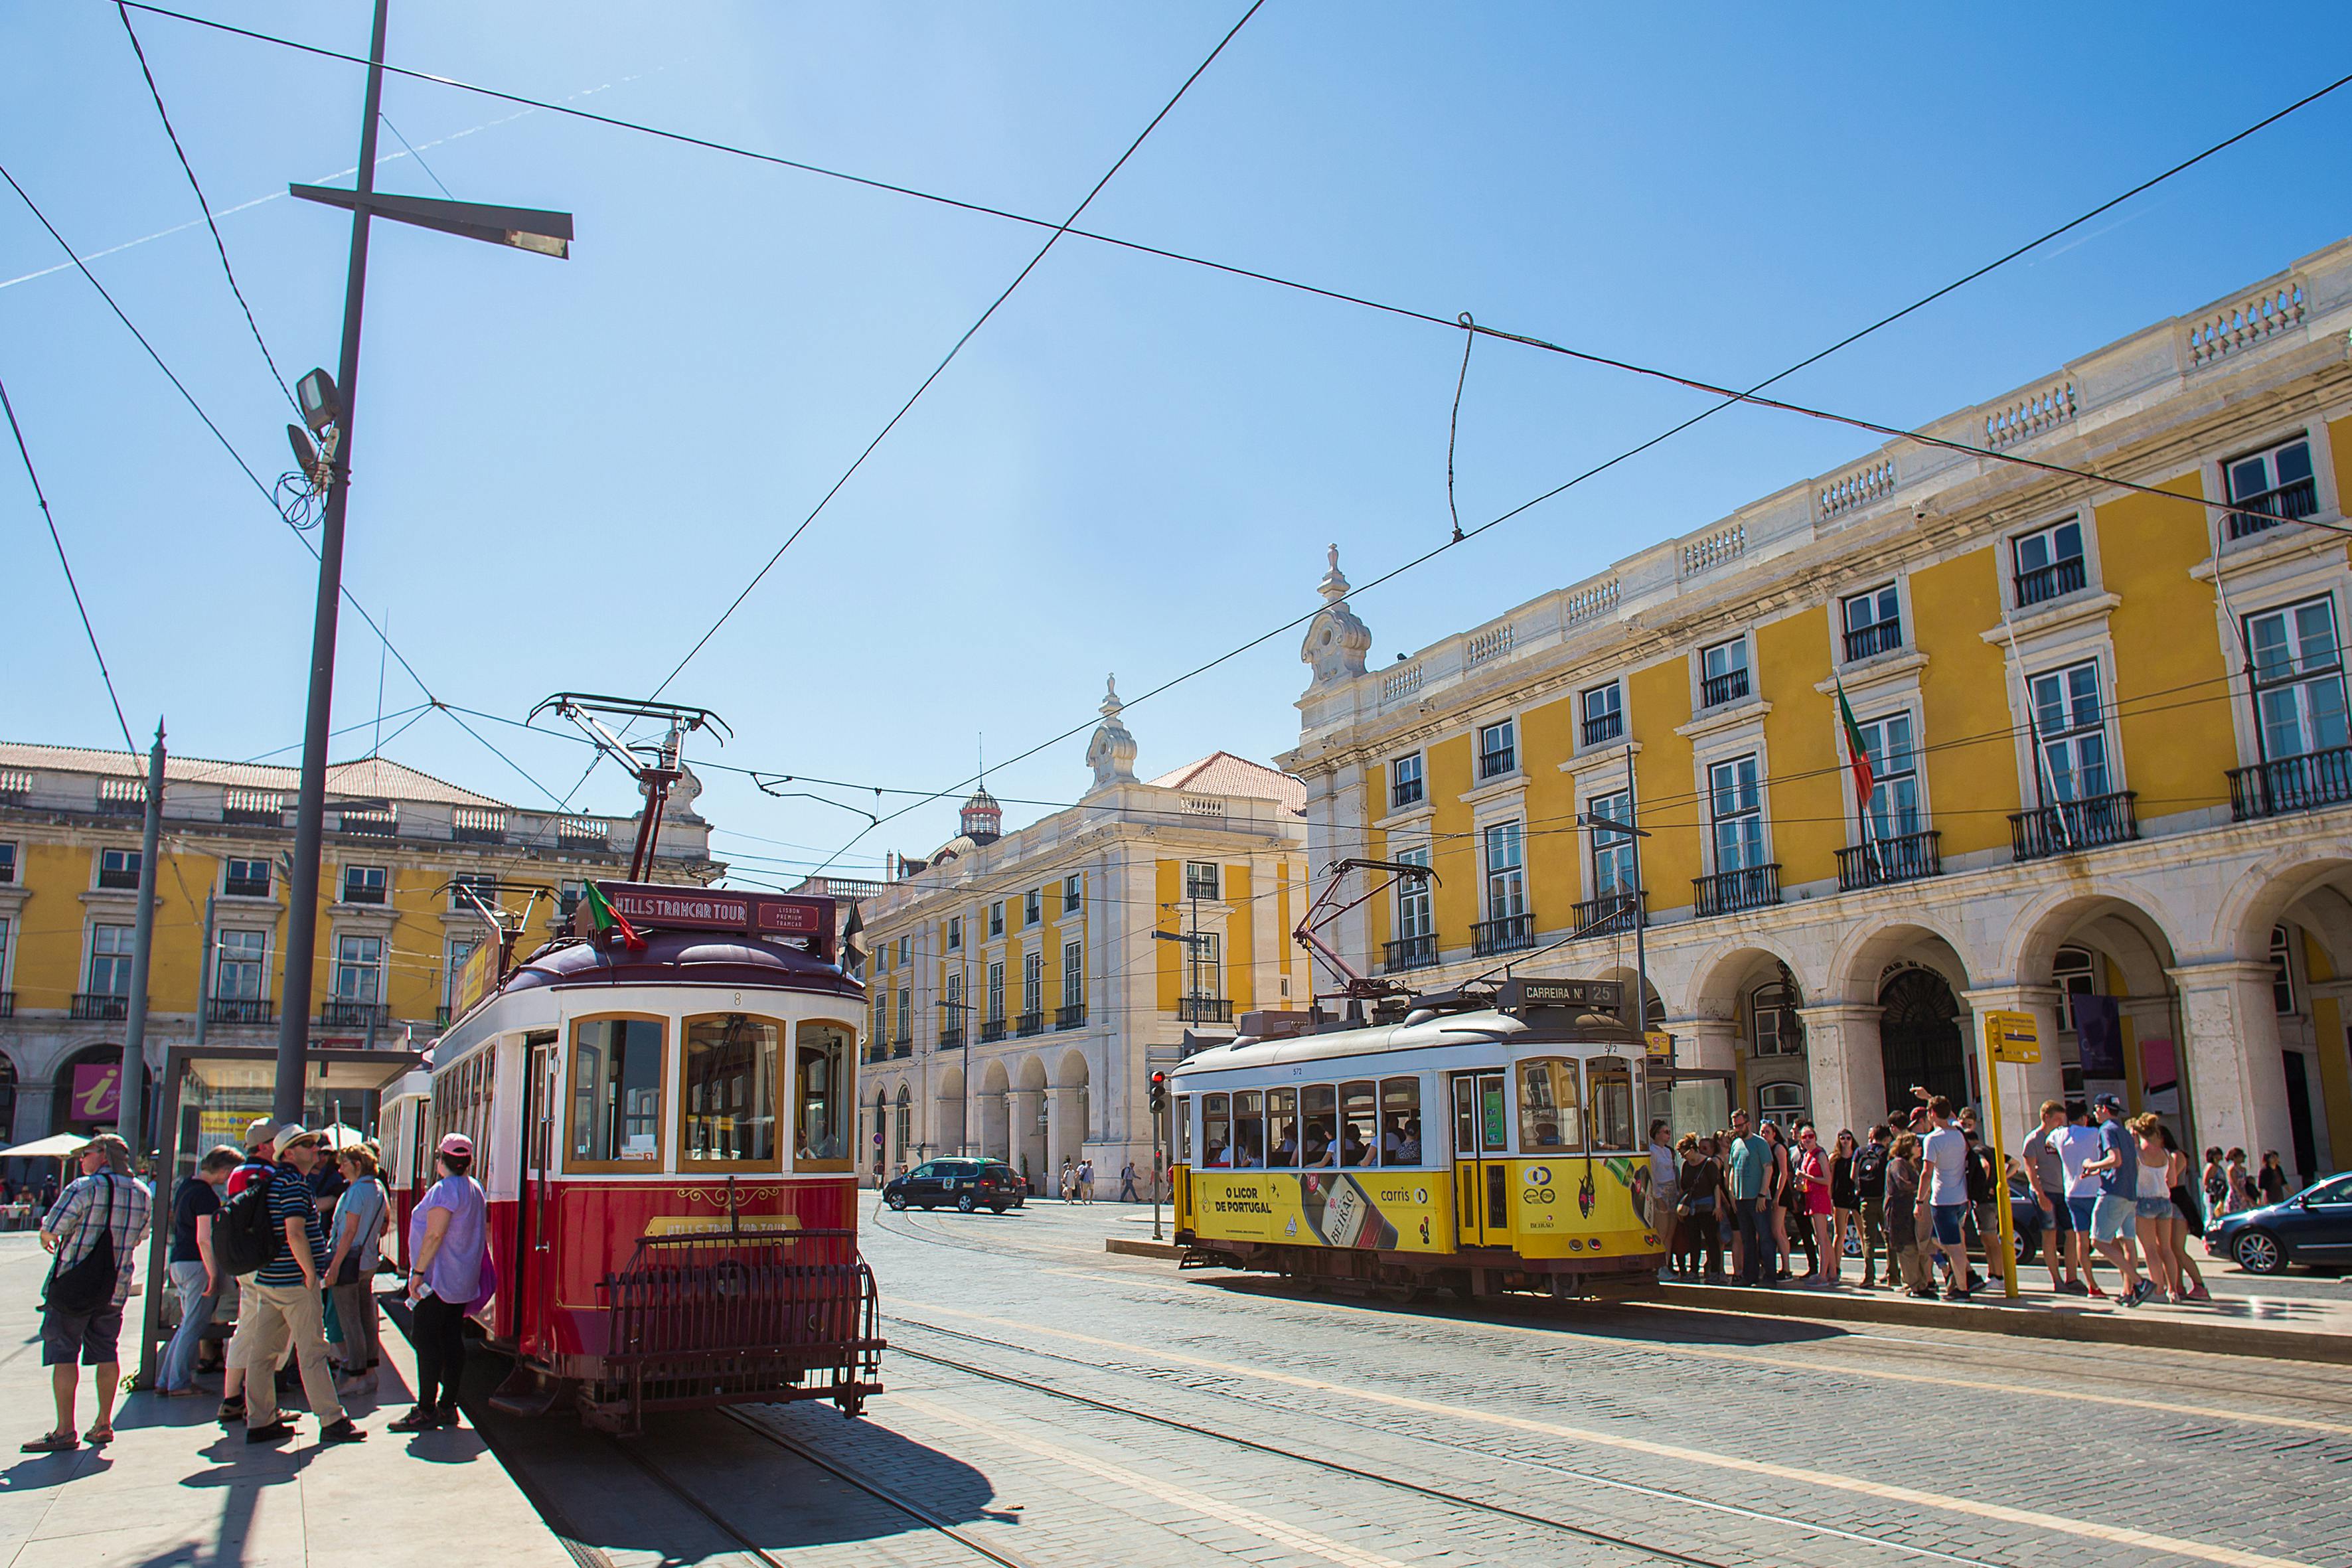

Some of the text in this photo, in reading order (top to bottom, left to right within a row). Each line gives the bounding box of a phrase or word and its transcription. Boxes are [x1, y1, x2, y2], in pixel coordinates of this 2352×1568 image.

[615, 898, 745, 921] HILLS TRAMCAR TOUR
[734, 992, 742, 1006] 8
[1527, 987, 1569, 998] CARREIRA
[1593, 986, 1609, 1000] 25
[1226, 1188, 1258, 1199] O LICOR
[1381, 1187, 1409, 1202] carris
[1215, 1202, 1272, 1214] DE PORTUGAL
[1330, 1190, 1354, 1245] BEIRÃO
